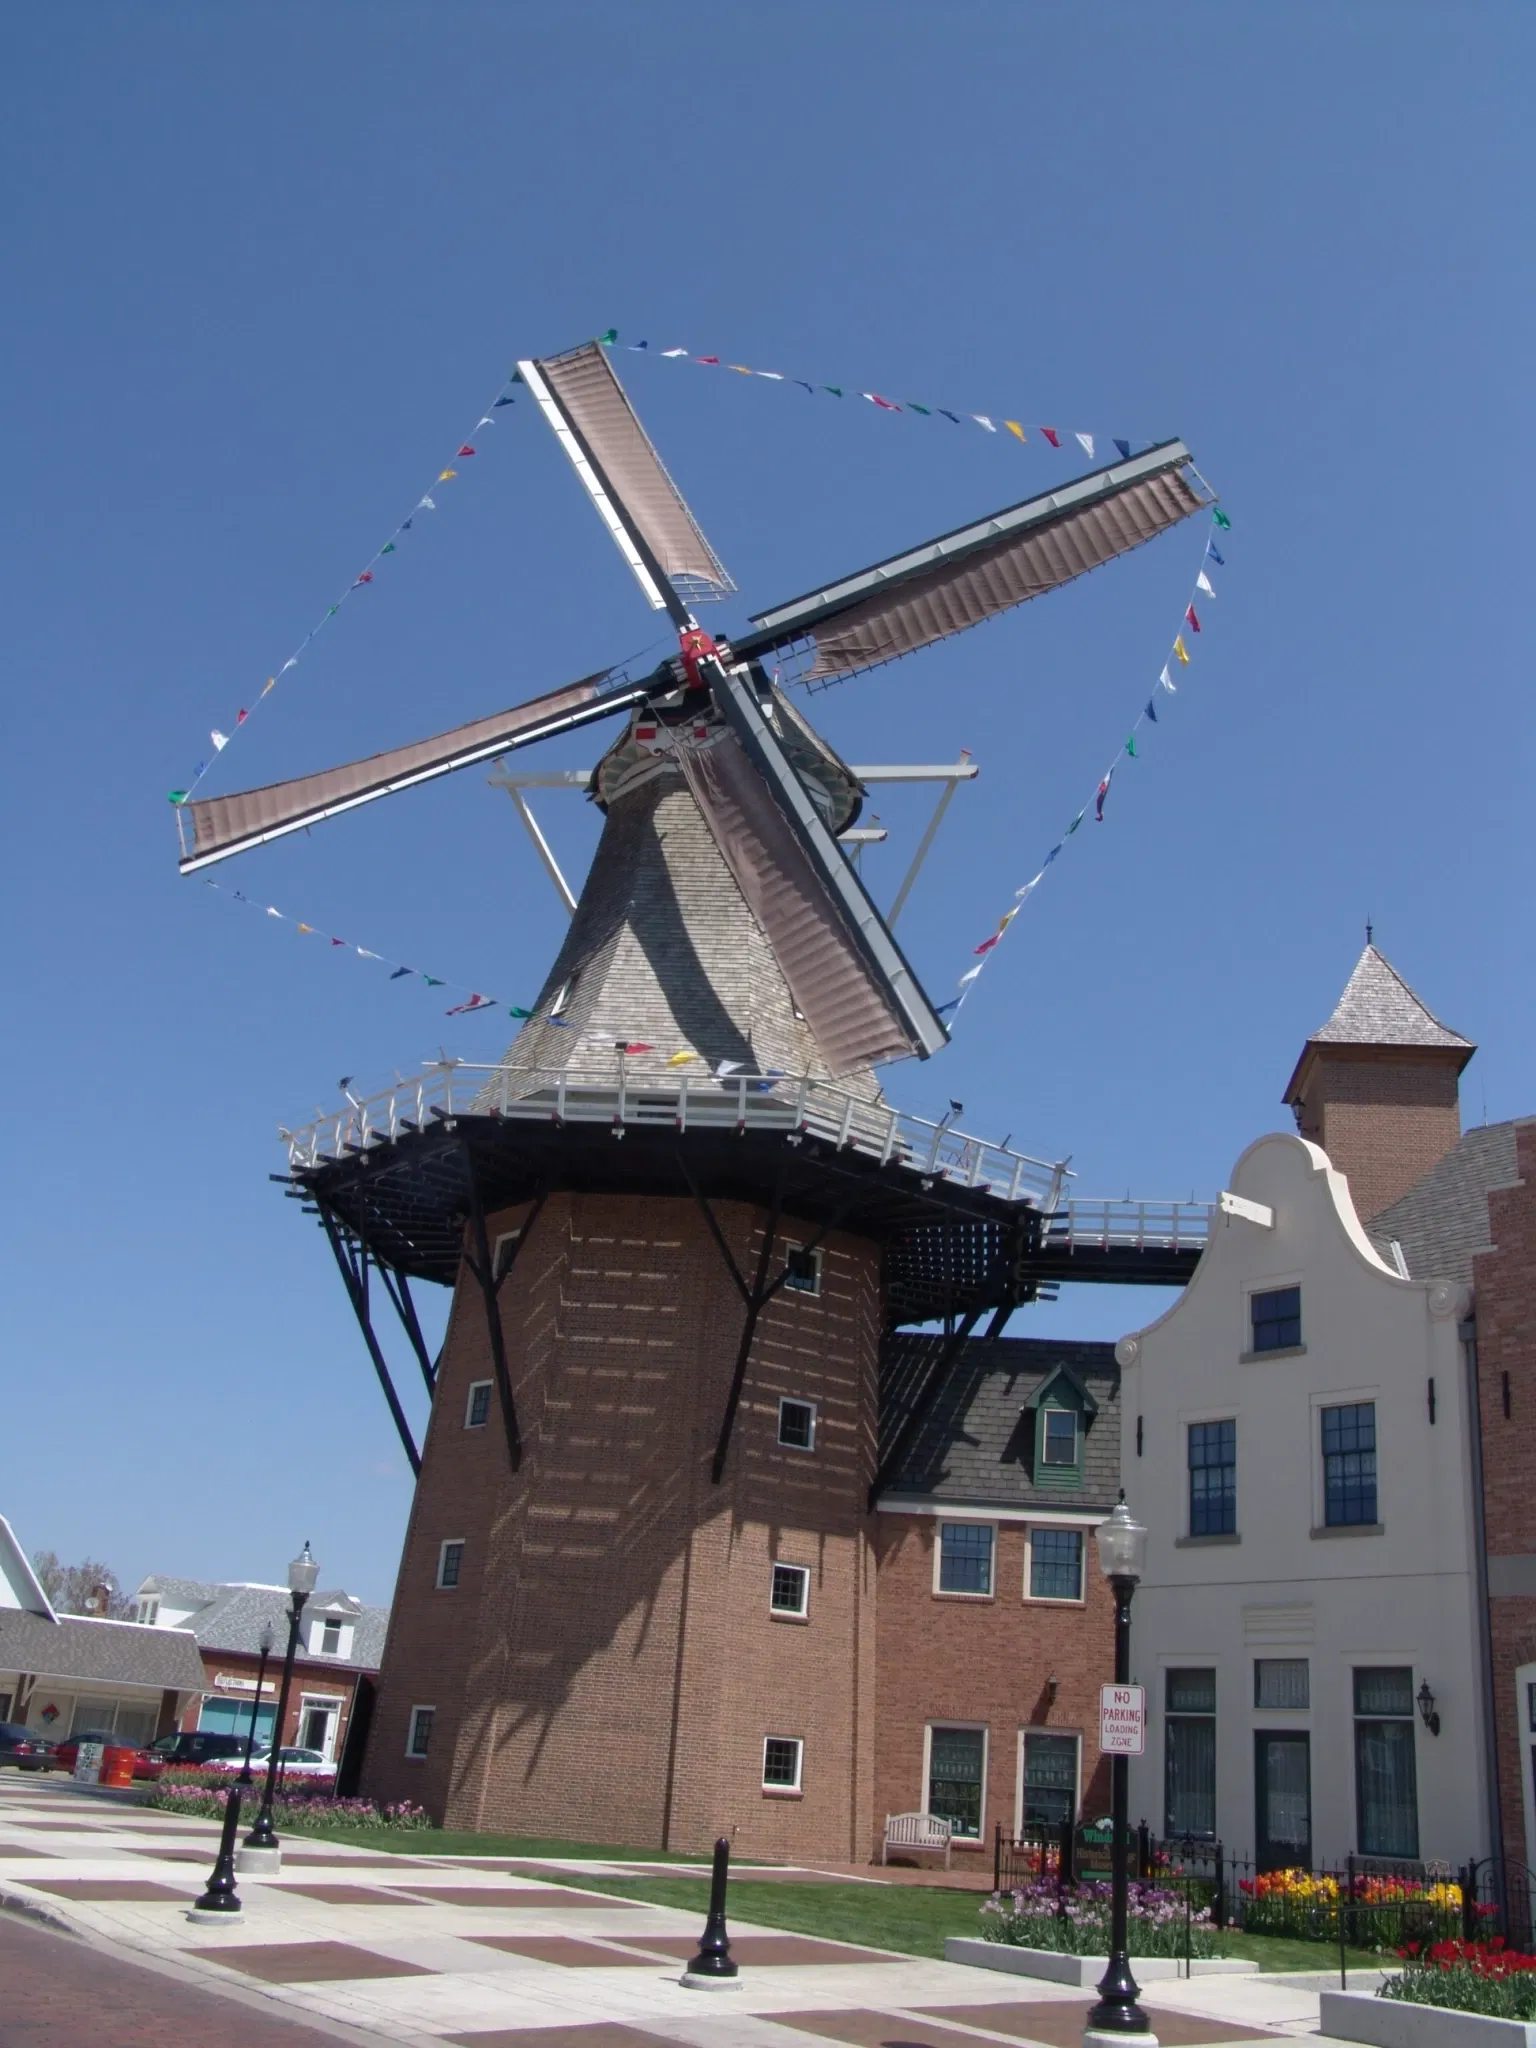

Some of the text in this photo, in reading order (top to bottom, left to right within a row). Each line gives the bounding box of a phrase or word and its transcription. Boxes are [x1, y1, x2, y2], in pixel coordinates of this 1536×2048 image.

[1114, 1691, 1130, 1704] NO
[1103, 1708, 1141, 1722] PARKING
[1104, 1724, 1139, 1735] LOADING
[1111, 1737, 1132, 1747] ZONE
